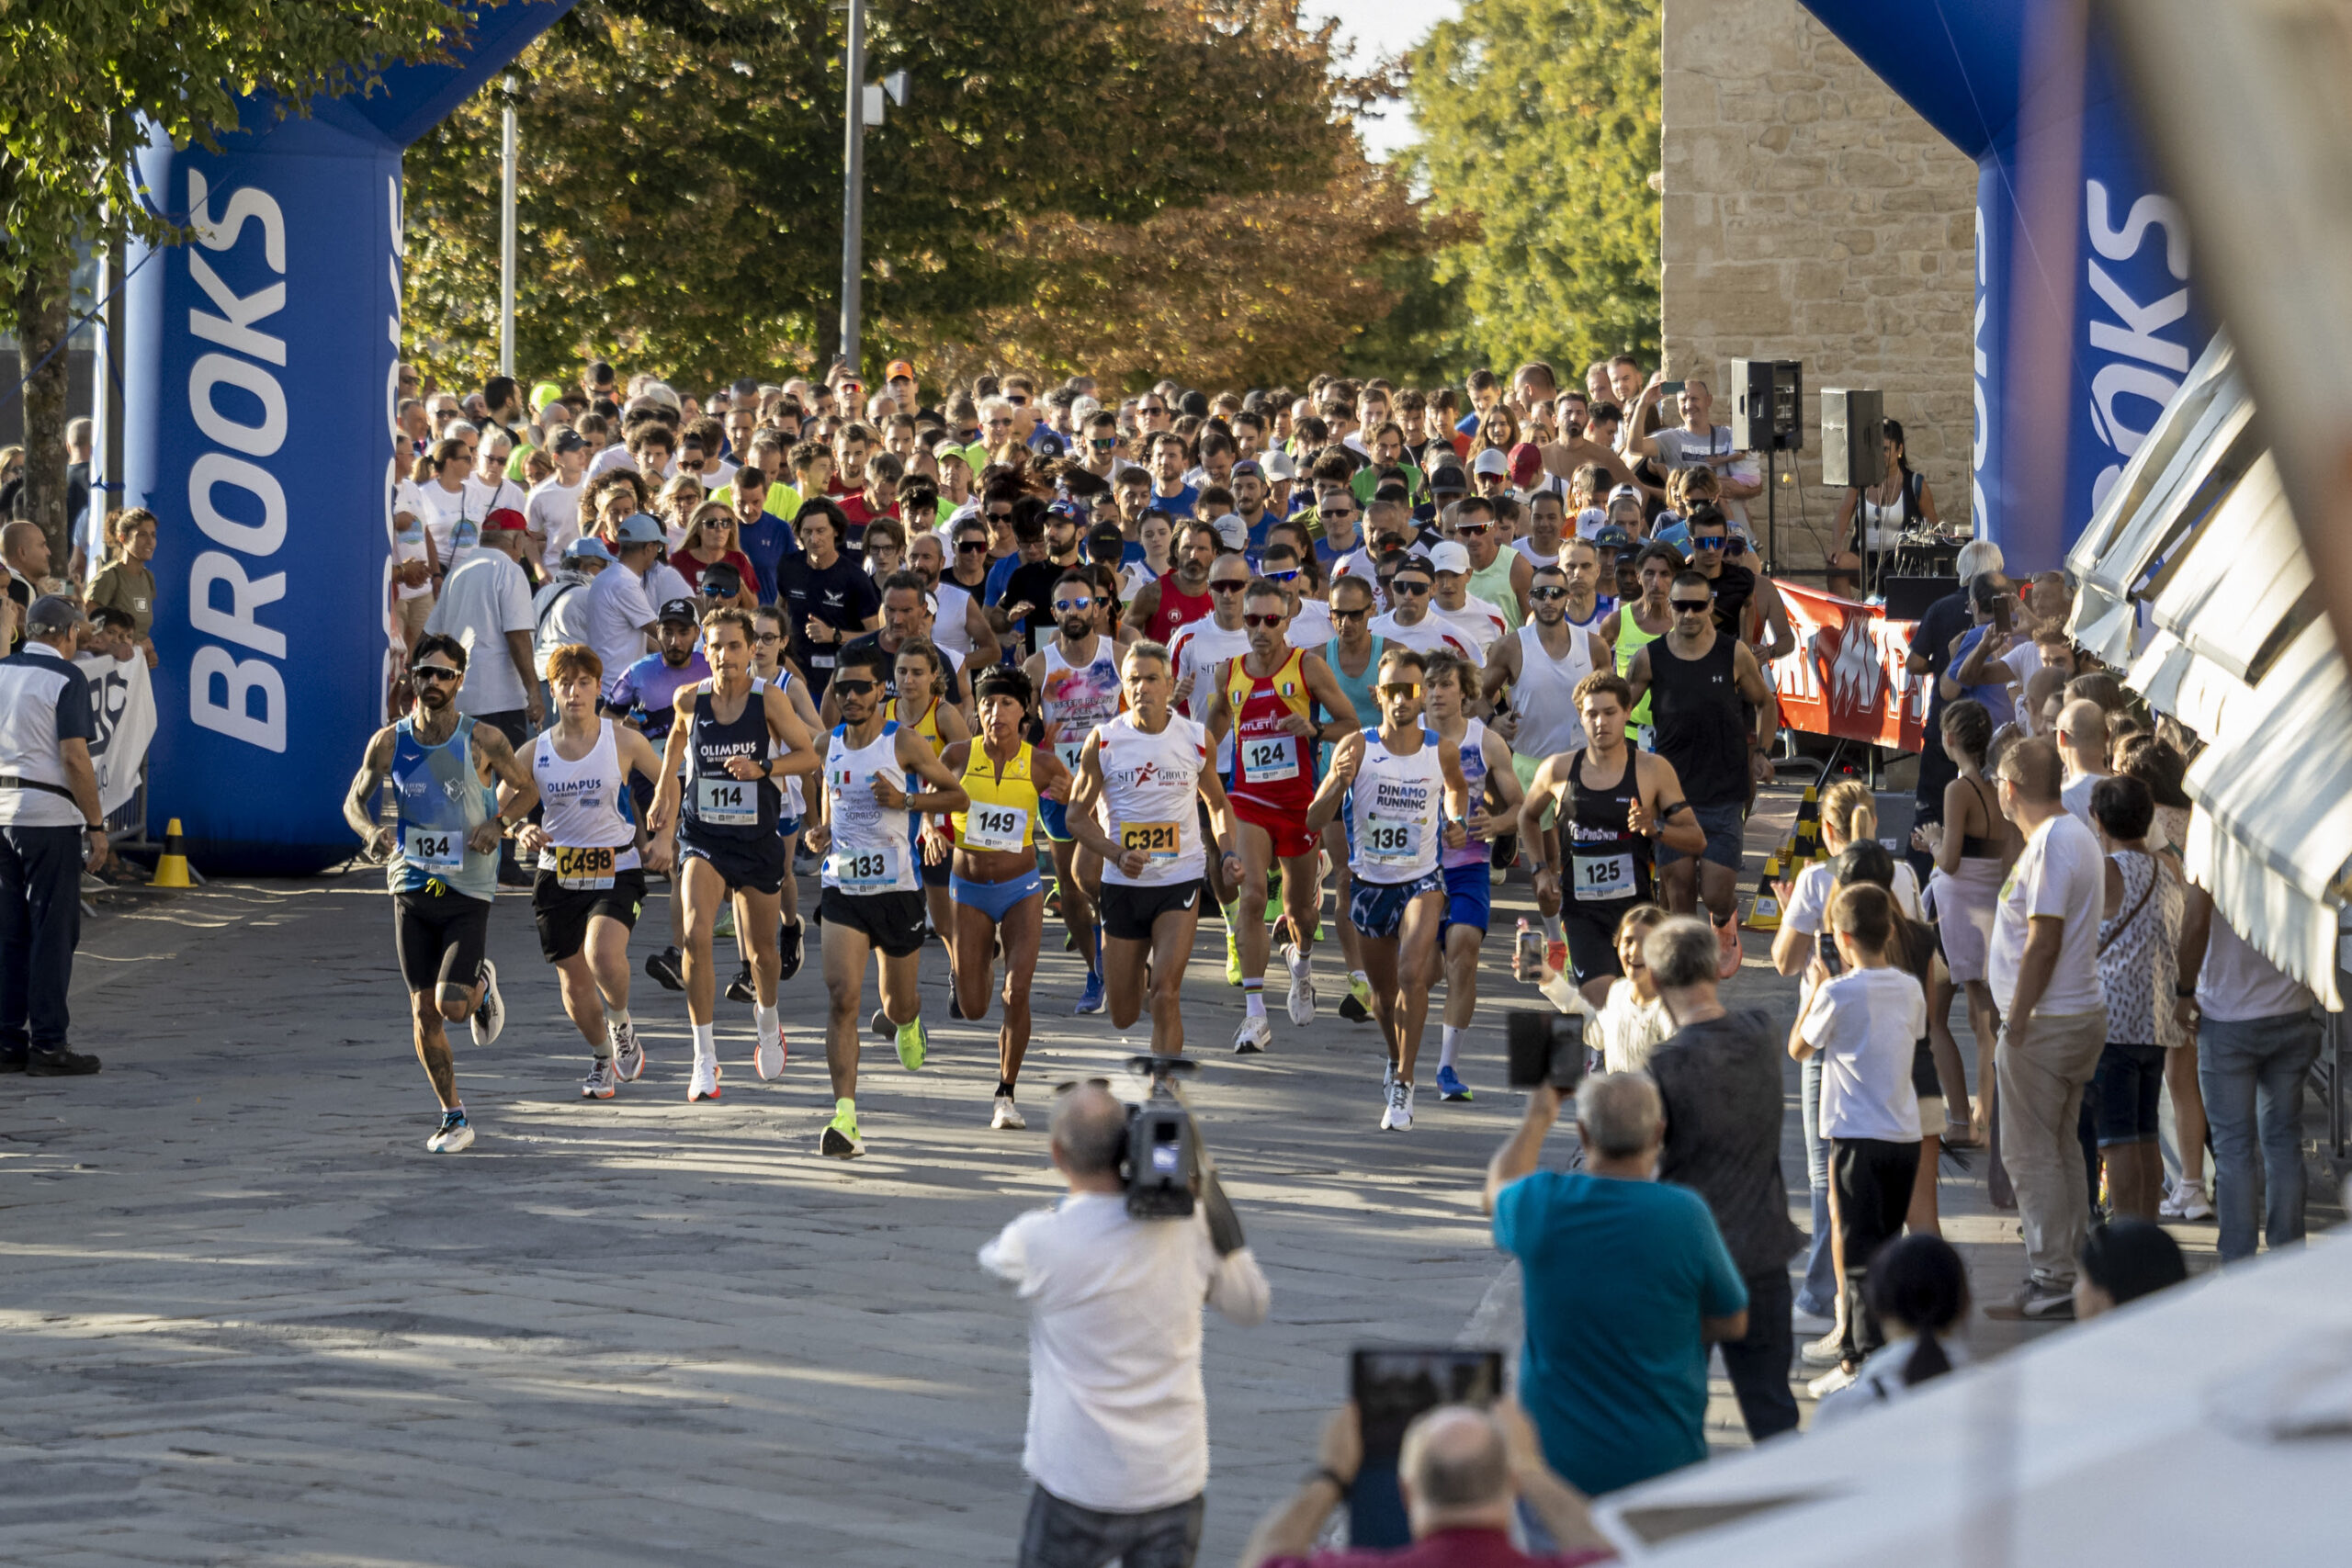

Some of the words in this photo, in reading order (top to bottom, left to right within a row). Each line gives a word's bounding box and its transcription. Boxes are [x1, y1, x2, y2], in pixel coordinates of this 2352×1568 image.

[188, 167, 288, 753] BROOKS
[701, 741, 756, 756] OLIMPUS
[1251, 742, 1284, 767] 124
[548, 779, 601, 793] OLIMPUS
[1117, 771, 1135, 782] SIT
[1158, 770, 1188, 780] GROUP
[711, 786, 742, 807] 114
[1378, 784, 1427, 798] DINAMO
[1376, 795, 1426, 810] RUNNING
[979, 811, 1015, 833] 149
[415, 836, 449, 858] 134
[1125, 827, 1173, 851] C321
[1372, 828, 1408, 849] 136
[560, 849, 612, 874] C498
[849, 854, 885, 878] 133
[1586, 860, 1620, 885] 125
